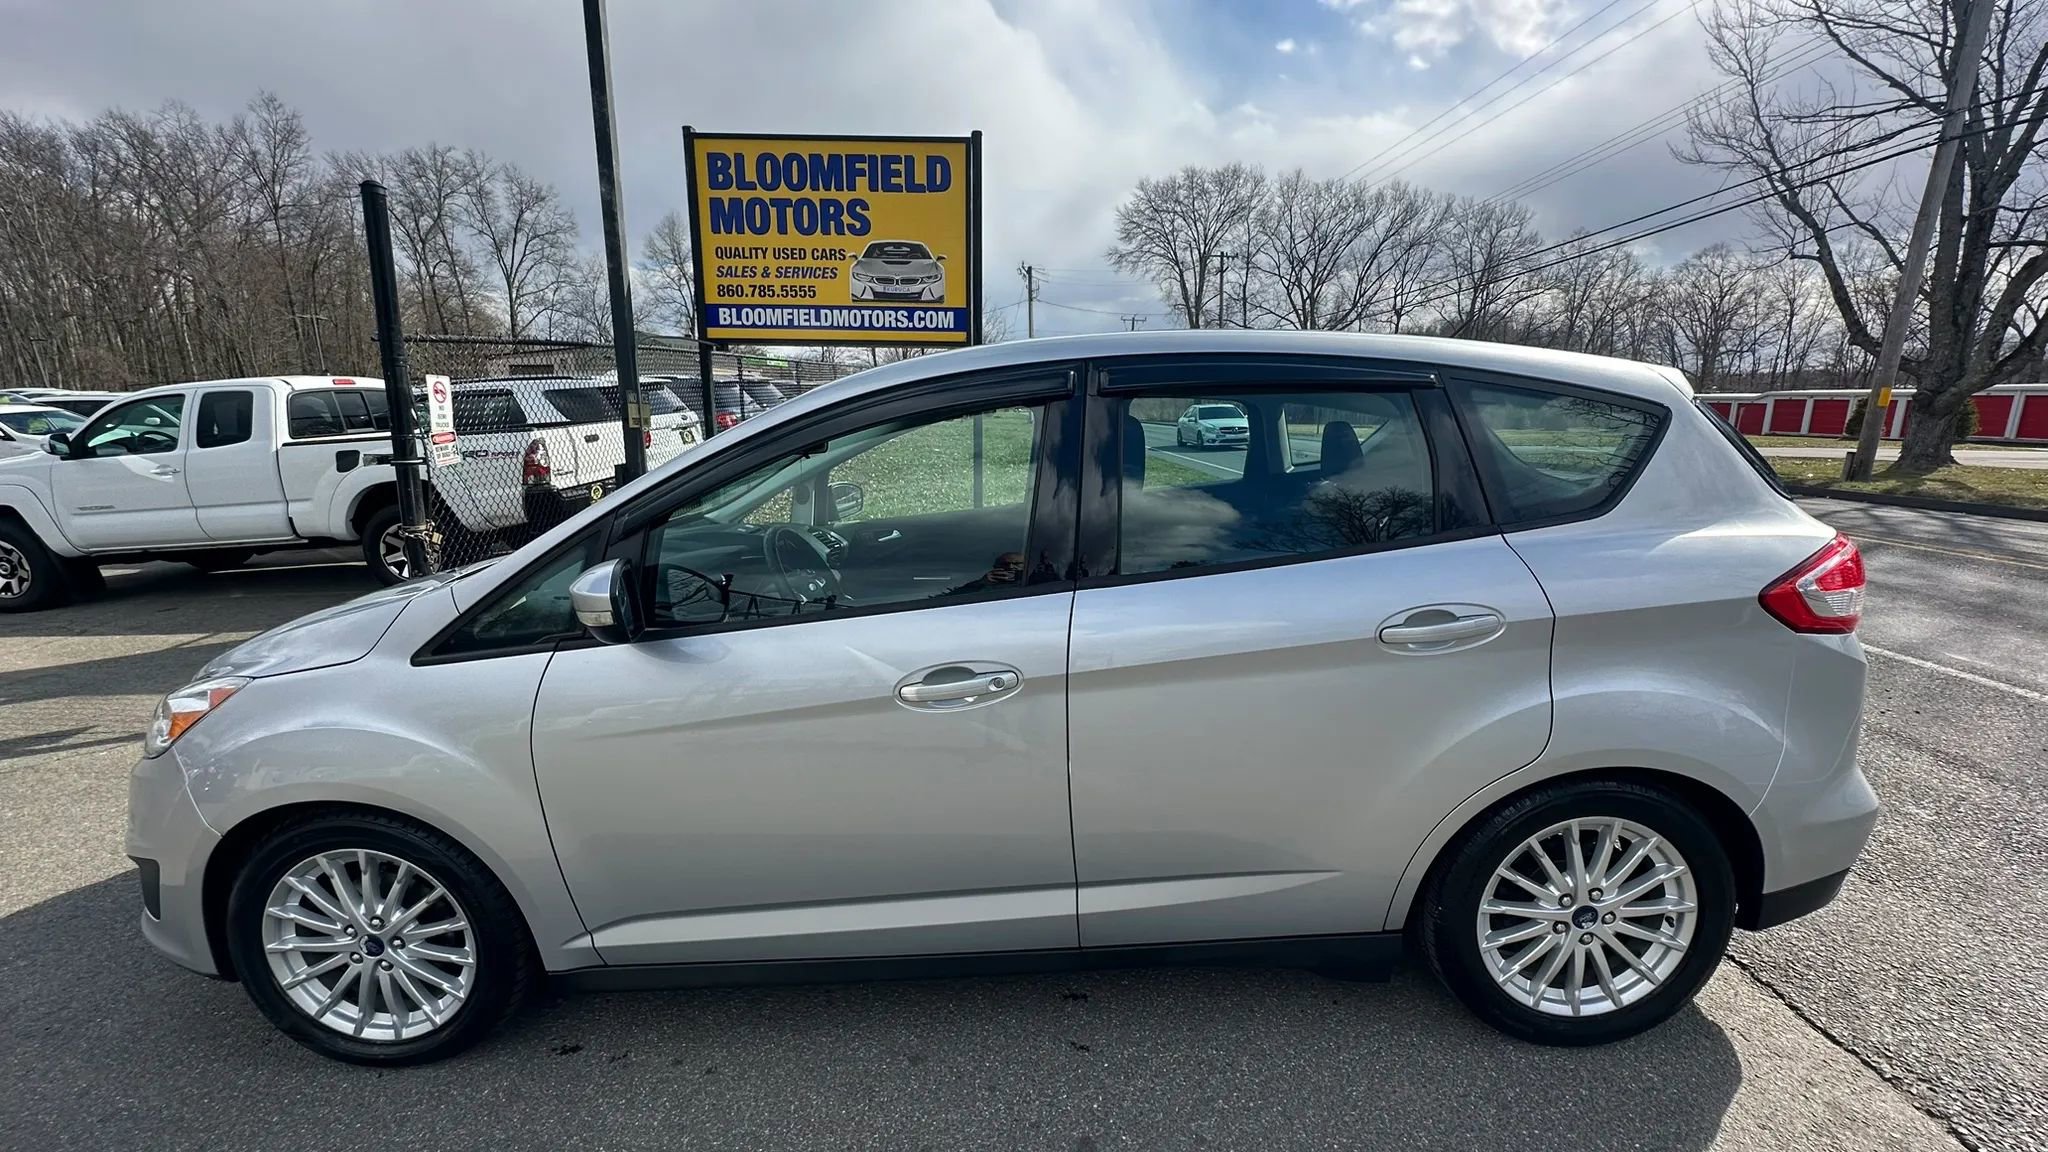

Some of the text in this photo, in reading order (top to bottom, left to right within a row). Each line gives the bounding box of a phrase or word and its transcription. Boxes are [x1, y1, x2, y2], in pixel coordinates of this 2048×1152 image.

[706, 152, 952, 193] BLOOMFIELD
[709, 197, 872, 236] MOTORS
[715, 246, 847, 261] QUALITY USED CARS
[716, 265, 838, 279] SALES & SERVICES
[717, 284, 816, 299] 860.785.5555
[718, 307, 954, 329] BLOOMFIELDMOTORS.COM
